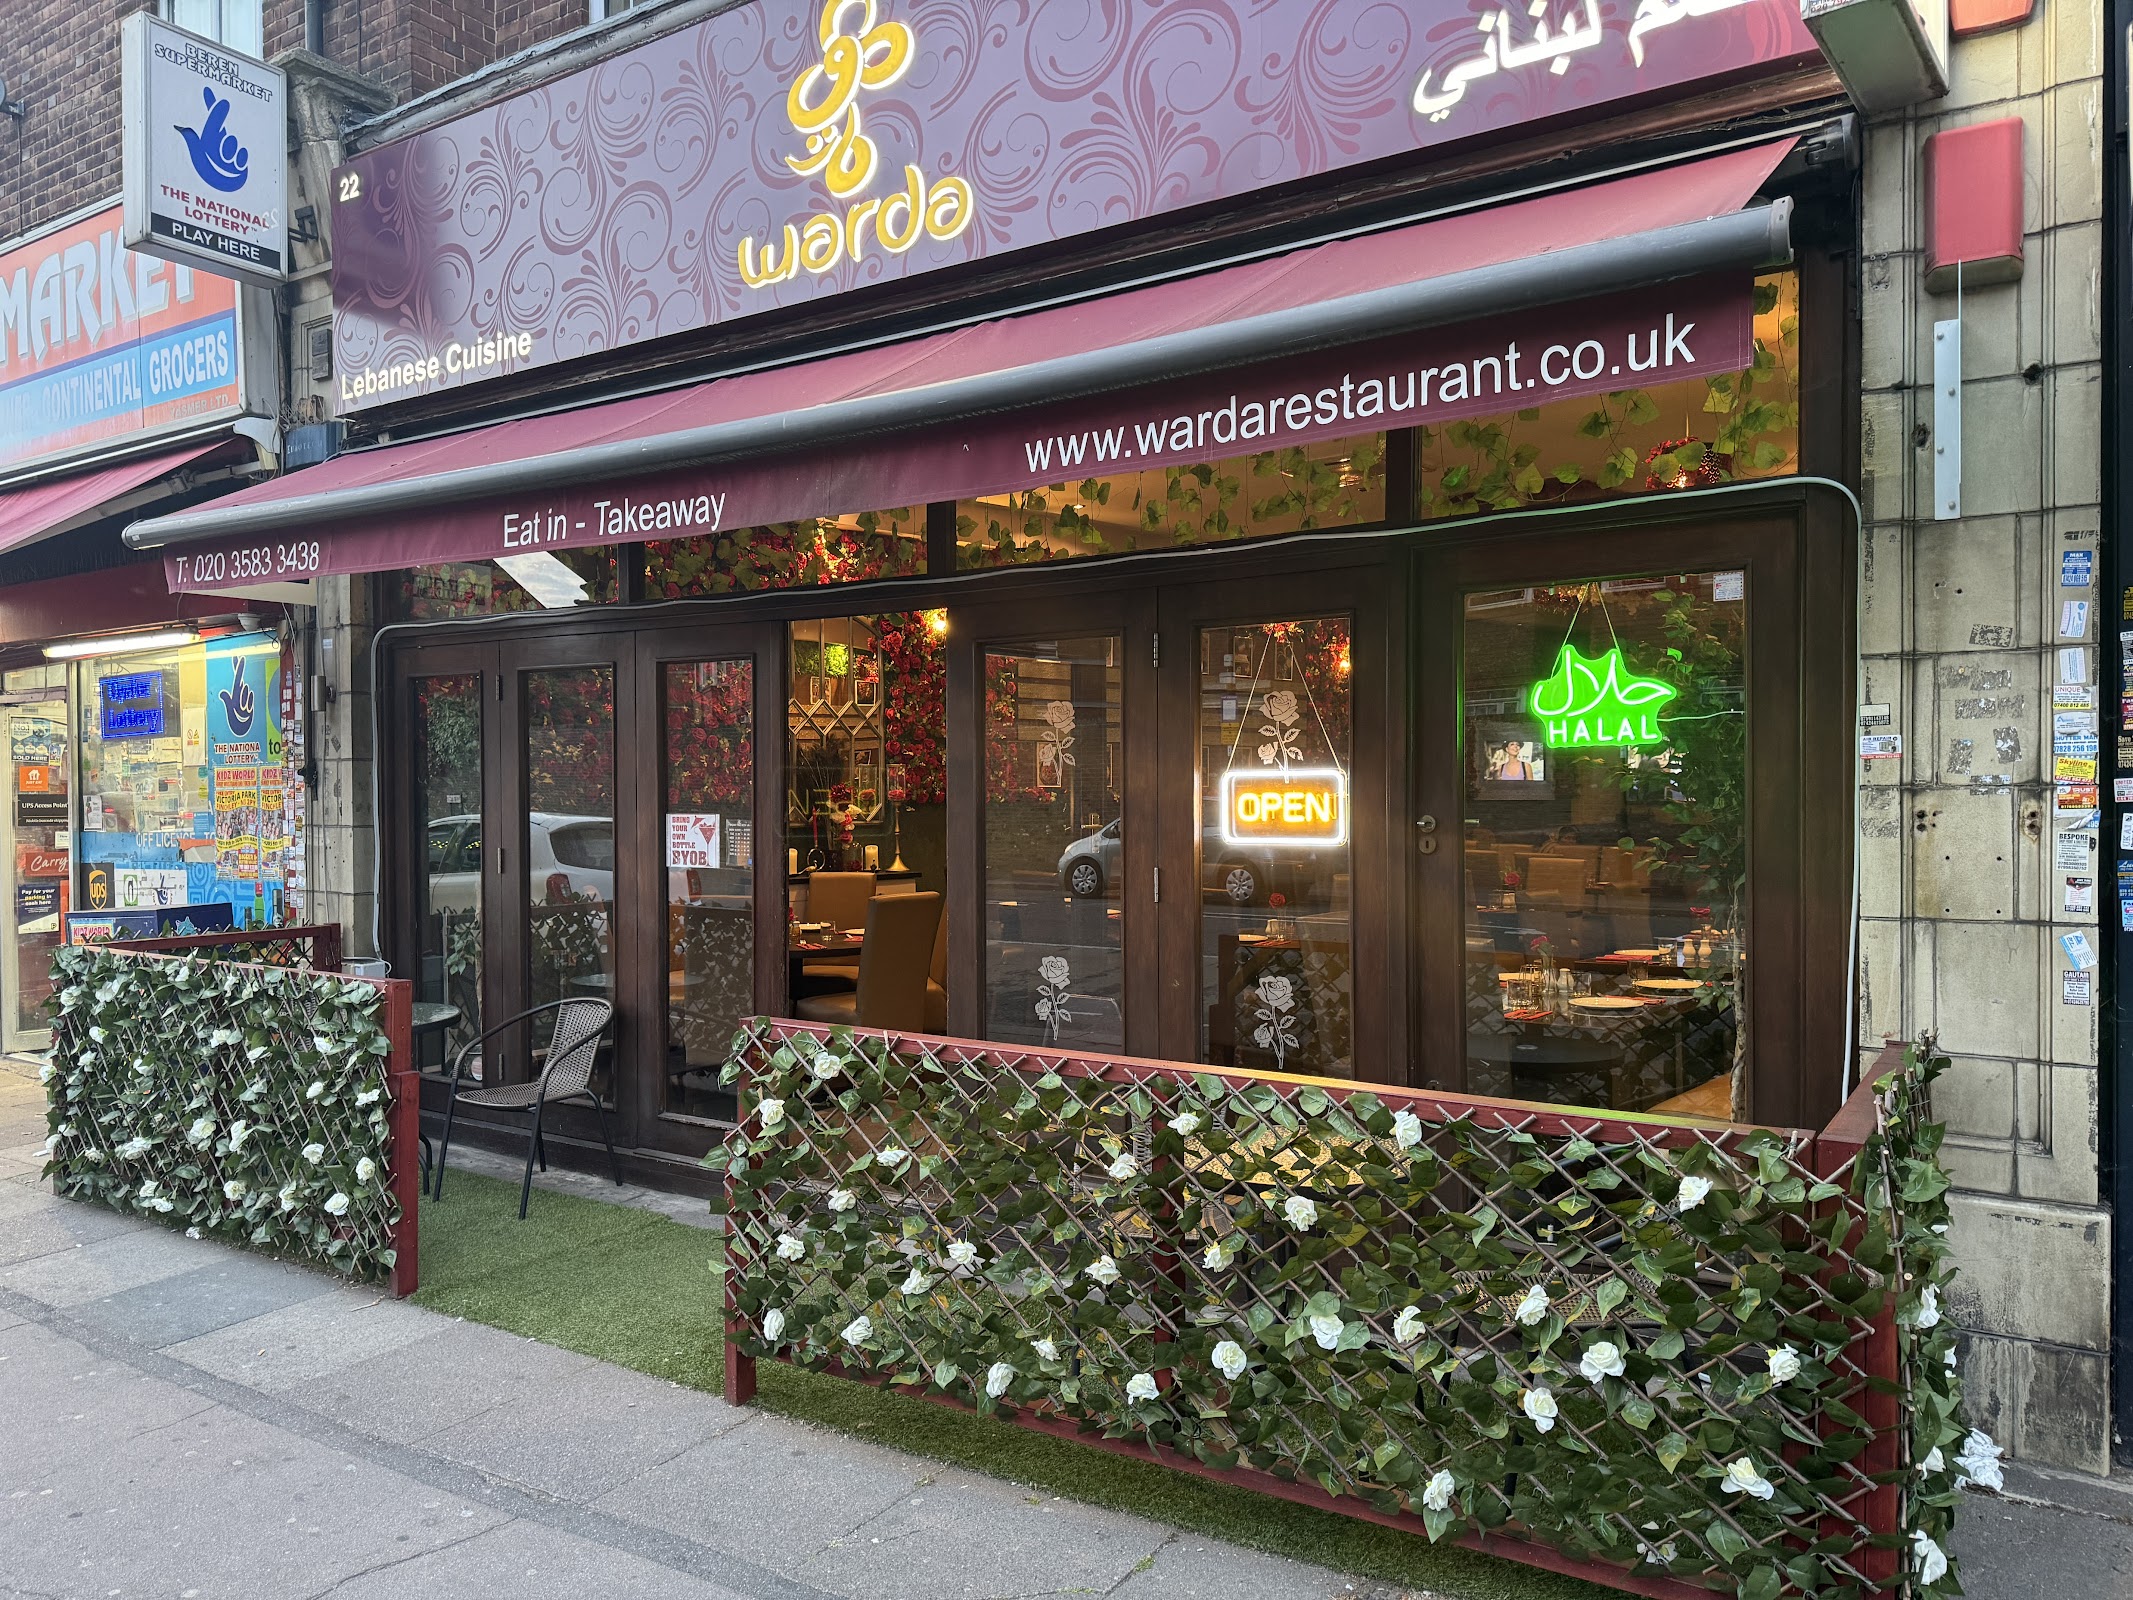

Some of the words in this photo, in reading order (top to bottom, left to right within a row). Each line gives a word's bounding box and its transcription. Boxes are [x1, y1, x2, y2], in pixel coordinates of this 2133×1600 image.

[185, 43, 239, 76] BEREN
[1412, 0, 1601, 123] لبناني
[154, 43, 273, 103] SUPERMARKET
[339, 173, 360, 202] 22
[160, 184, 190, 204] THE
[195, 195, 270, 230] NATIONAL
[738, 164, 974, 288] warda
[172, 222, 213, 246] PLAY
[218, 235, 260, 260] HERE
[43, 358, 142, 423] CONTINENTAL
[150, 330, 228, 396] GROCERS
[341, 355, 440, 400] Lebanese
[446, 331, 533, 374] Cuisine
[1025, 312, 1696, 474] www.wardarestaurant.co.uk
[503, 513, 540, 549] Eat
[546, 508, 566, 540] in
[593, 492, 726, 536] Takeaway
[176, 555, 188, 584] T:
[193, 553, 225, 583] 020
[230, 549, 271, 580] 3583
[276, 541, 320, 572] 3438
[1533, 649, 1673, 718] حلال
[1548, 714, 1658, 744] HALAL
[214, 744, 228, 753] THE
[2058, 758, 2089, 768] Skyline
[216, 770, 231, 781] KIDZ
[232, 769, 256, 780] WORLD
[216, 792, 241, 804] VICTORIA
[241, 790, 256, 800] PARK
[216, 801, 237, 811] FINCHLEY
[1237, 791, 1331, 823] OPEN
[671, 816, 690, 824] BRING
[672, 824, 688, 832] YOUR
[136, 833, 154, 848] OFF
[672, 833, 686, 841] OWN
[672, 841, 696, 849] BOTTLE
[2058, 833, 2089, 841] BESPOKE
[31, 855, 68, 872] Carry
[672, 850, 707, 866] BYOB
[24, 894, 46, 902] parking
[91, 882, 106, 905] ups
[2064, 971, 2089, 979] GAUTAM
